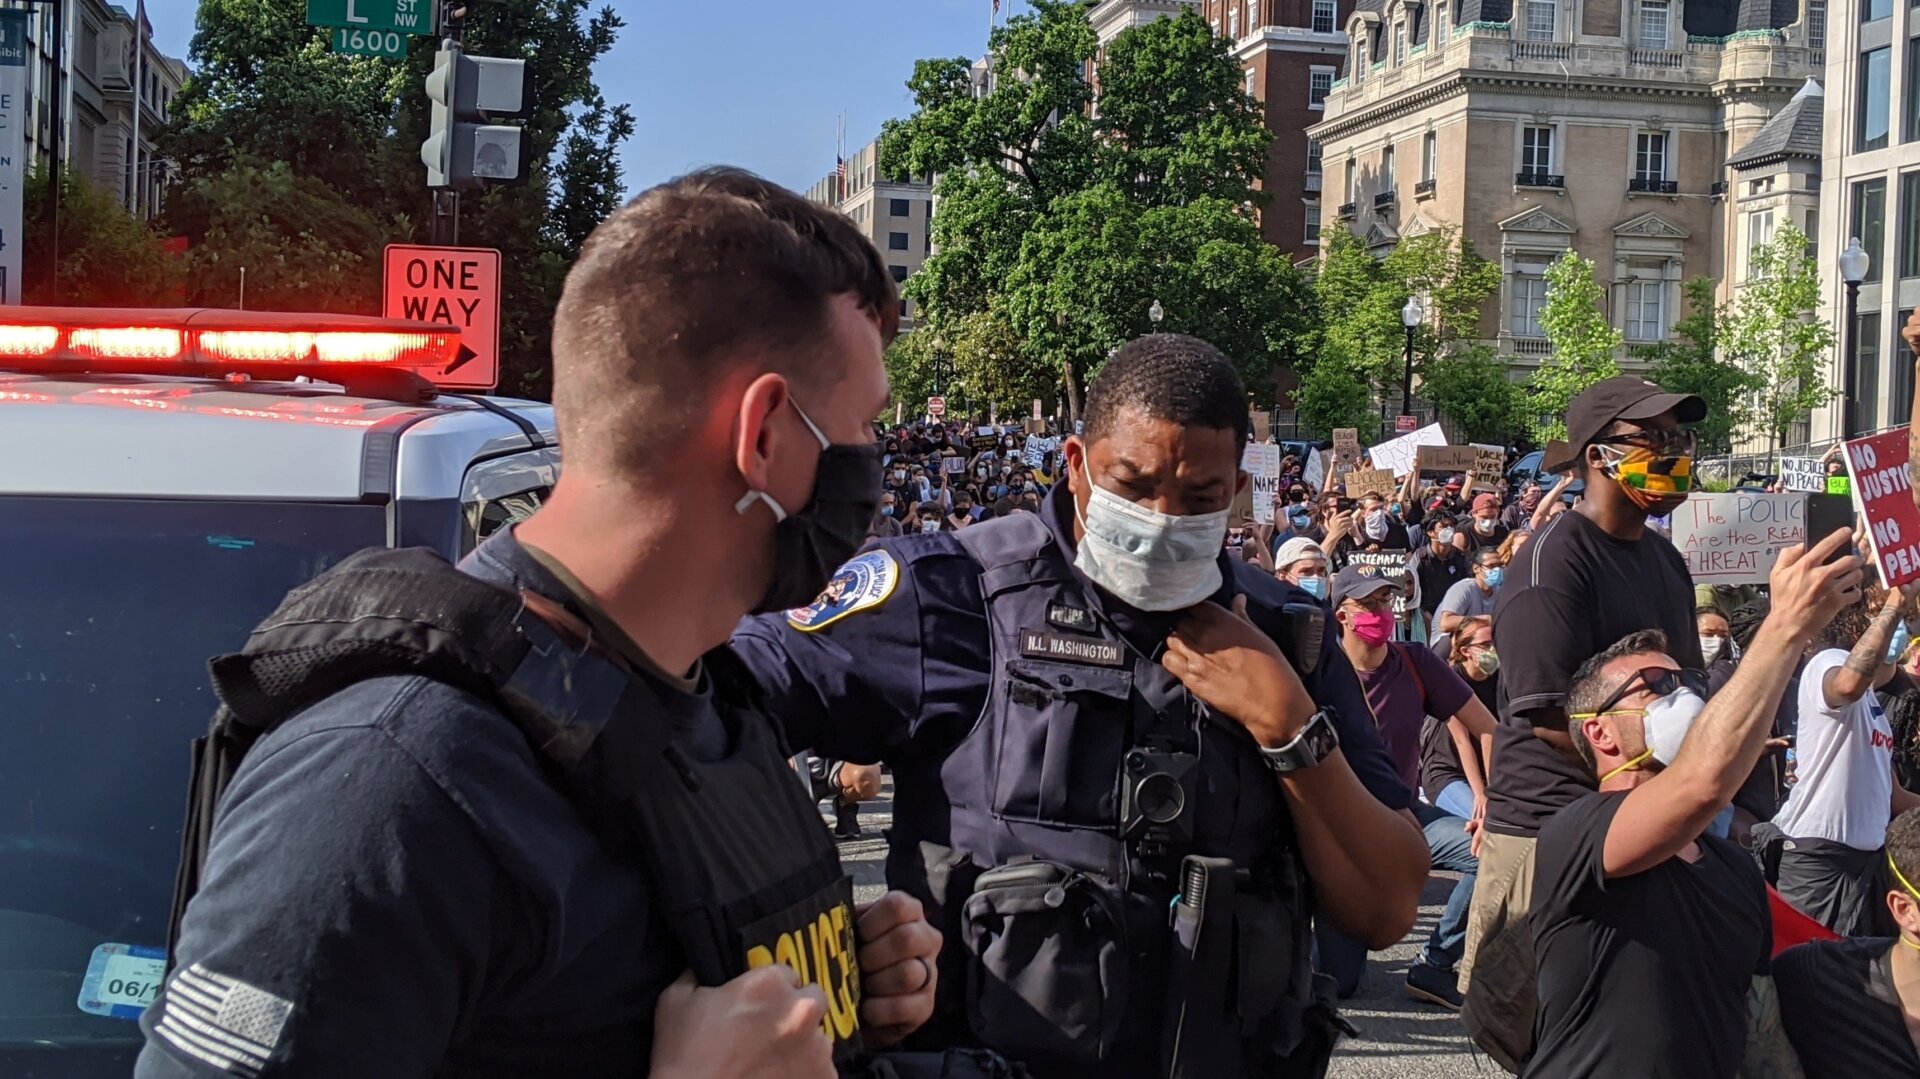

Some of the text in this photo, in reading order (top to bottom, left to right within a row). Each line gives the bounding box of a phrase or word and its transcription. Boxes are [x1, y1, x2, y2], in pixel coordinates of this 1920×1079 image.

[346, 0, 418, 23] L ST
[394, 13, 418, 27] NW
[340, 28, 400, 53] 1600
[0, 47, 22, 58] ibit
[406, 258, 479, 290] ONE
[402, 296, 481, 327] WAY
[1477, 461, 1501, 472] IVES
[1782, 458, 1824, 475] NO JUSTICE
[1851, 443, 1877, 472] NO
[1254, 476, 1279, 493] NAME
[1475, 472, 1500, 486] ATTER
[1782, 472, 1823, 490] NO PEACE
[1862, 462, 1912, 501] JUSTIC
[1686, 498, 1726, 529] The
[1737, 496, 1800, 523] POLIC
[1685, 526, 1804, 549] Are the REAL
[1873, 517, 1900, 549] NO
[1348, 553, 1406, 566] SYSTEMATIC
[1684, 550, 1759, 572] THREAT
[1885, 542, 1920, 580] PEA
[1027, 635, 1118, 661] N.L. WASHINGTON
[747, 902, 860, 1041] OLICE
